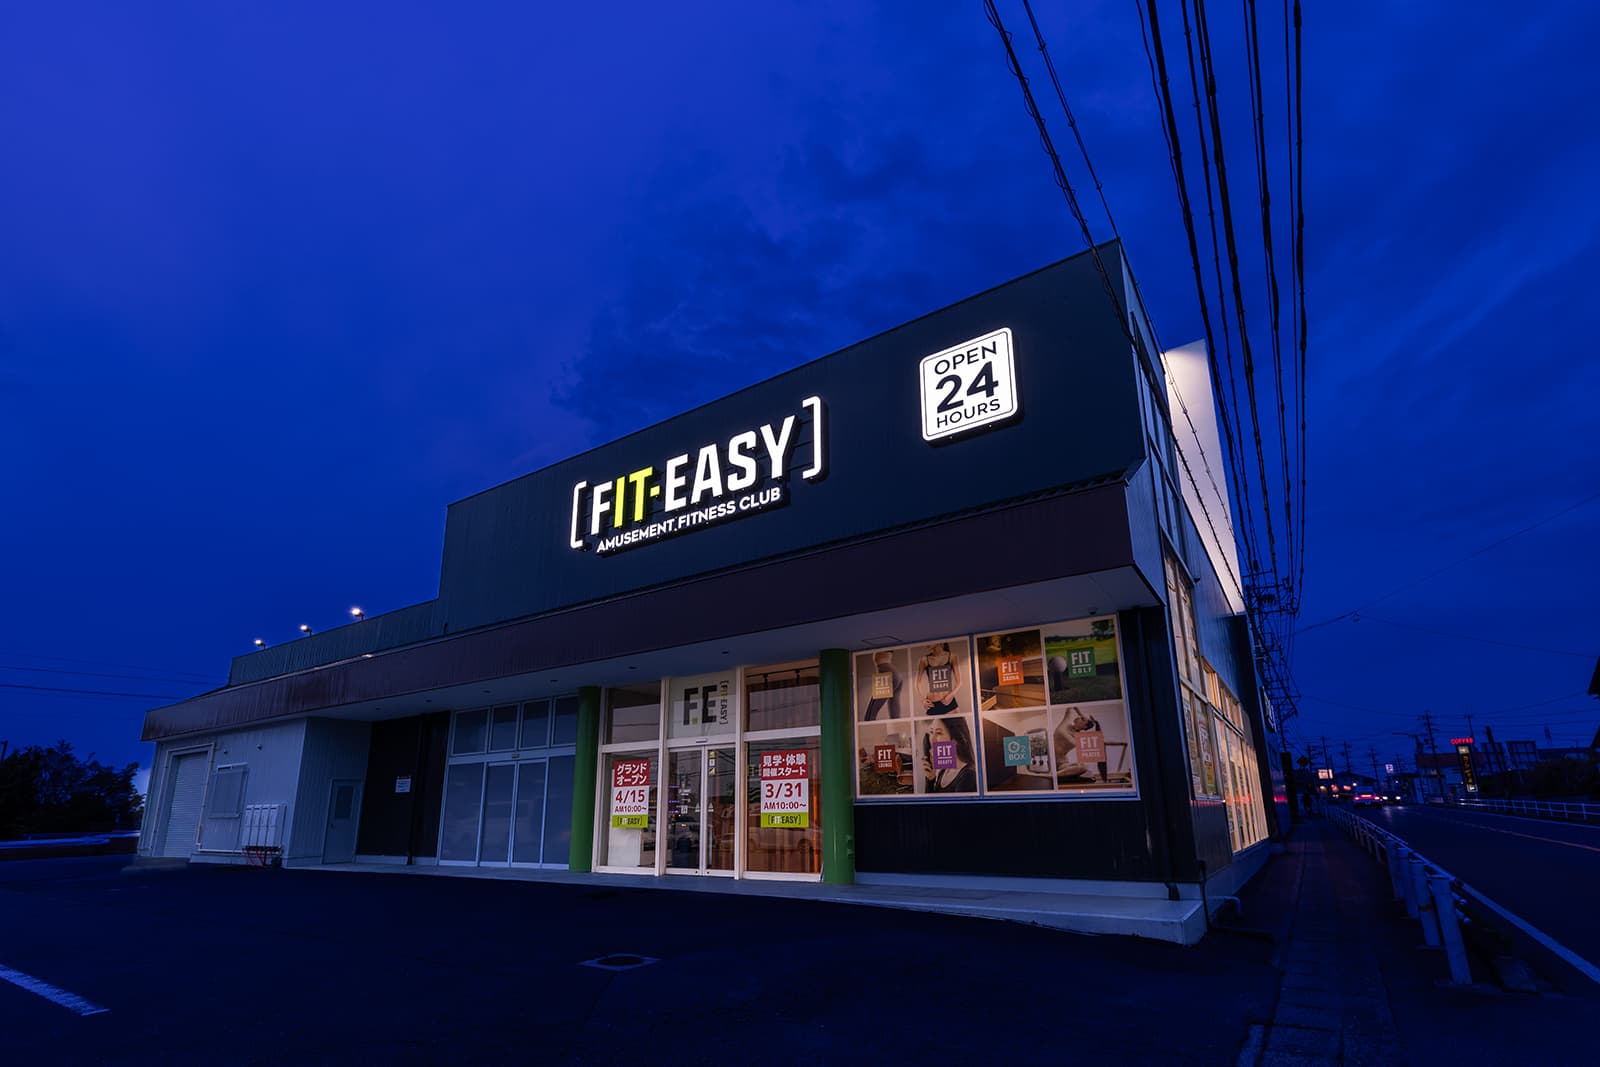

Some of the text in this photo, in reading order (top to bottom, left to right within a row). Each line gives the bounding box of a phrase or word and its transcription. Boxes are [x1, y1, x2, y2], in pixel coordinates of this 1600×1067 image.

[934, 341, 997, 375] OPEN
[936, 361, 999, 414] 24
[936, 399, 1000, 428] HOURS
[677, 501, 737, 530] FITNESS
[739, 487, 782, 511] CLUB
[1071, 651, 1090, 665] FIT
[1001, 661, 1018, 673] FIT
[875, 675, 890, 687] FIT
[932, 668, 949, 681] FIT
[1080, 736, 1098, 749] FIT
[878, 749, 892, 760] FIT
[936, 745, 952, 757] FIT
[1008, 753, 1026, 761] BOX
[616, 762, 648, 775] グランド
[616, 775, 648, 786] オープン
[615, 789, 646, 804] 4/15
[765, 782, 802, 798] 3/31
